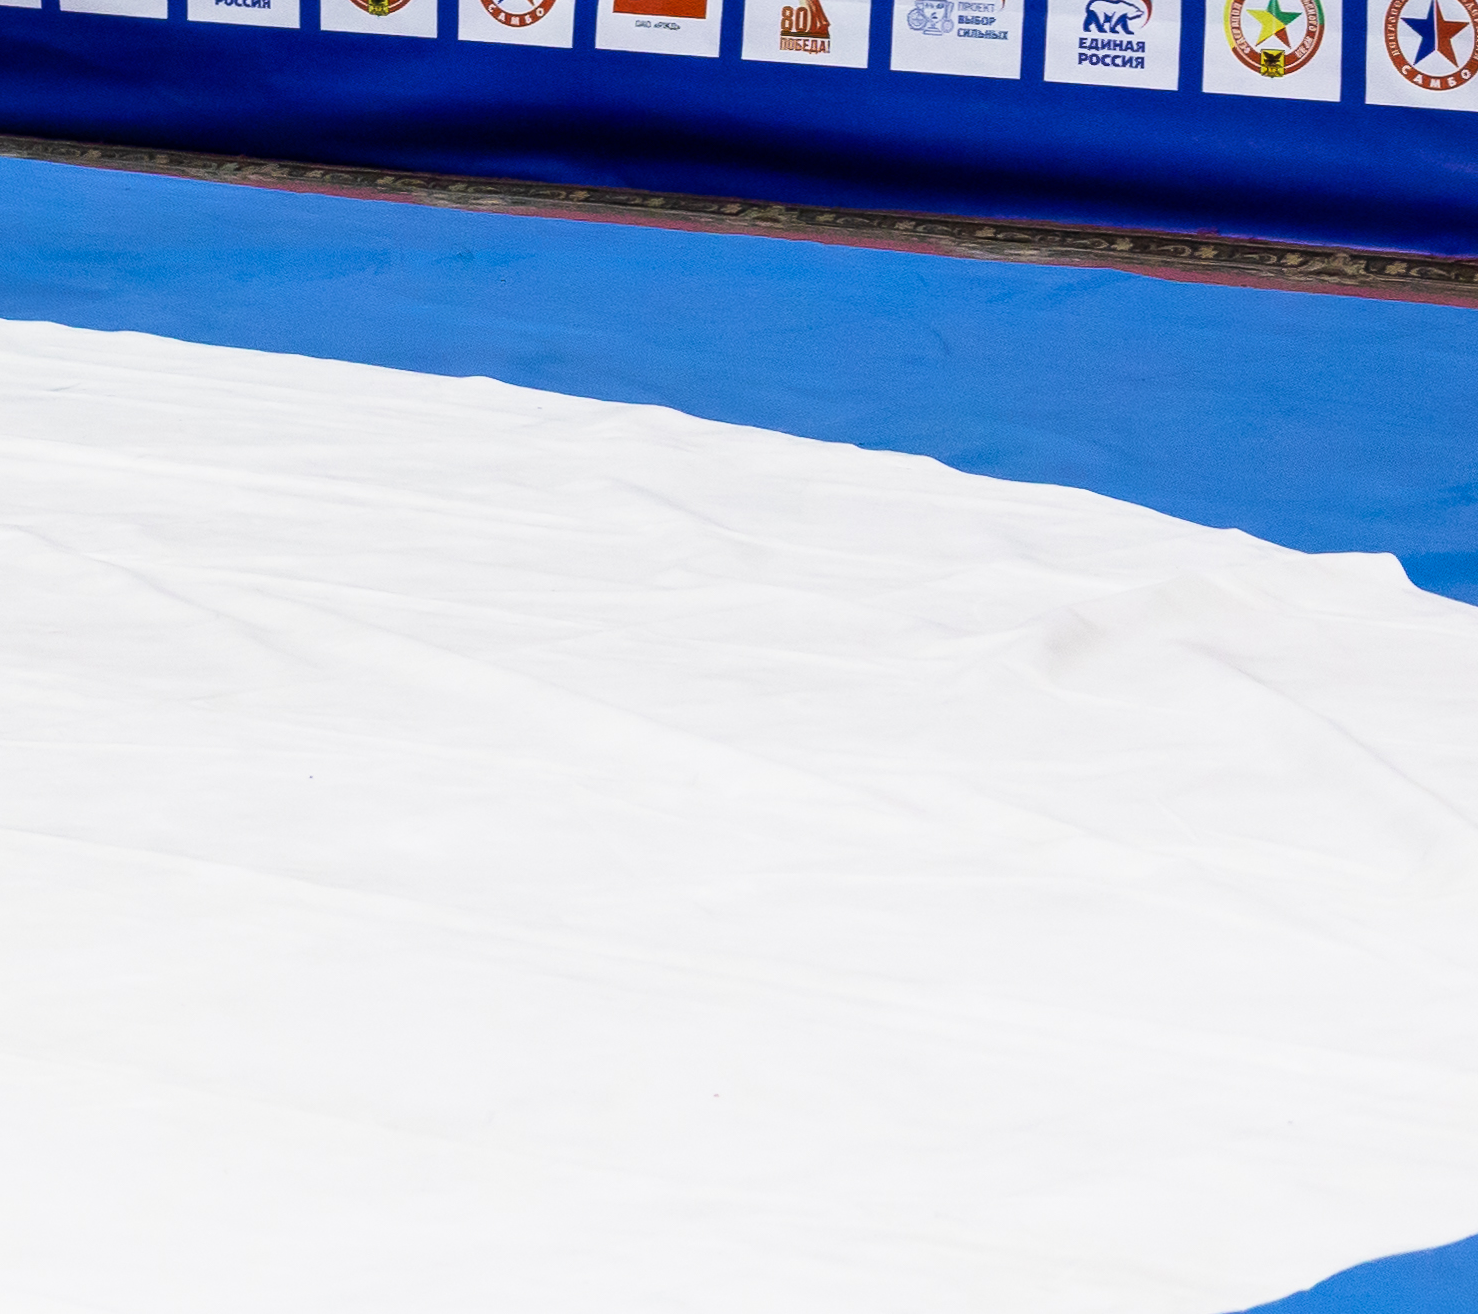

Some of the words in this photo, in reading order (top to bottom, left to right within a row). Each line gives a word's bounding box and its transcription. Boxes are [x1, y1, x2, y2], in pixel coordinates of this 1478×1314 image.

[488, 2, 548, 26] САМБО
[780, 35, 831, 55] ПОБЕДА!
[1079, 37, 1145, 54] ЕДИНАЯ
[1078, 53, 1145, 69] РОССИЯ
[1401, 64, 1472, 90] САМБО
